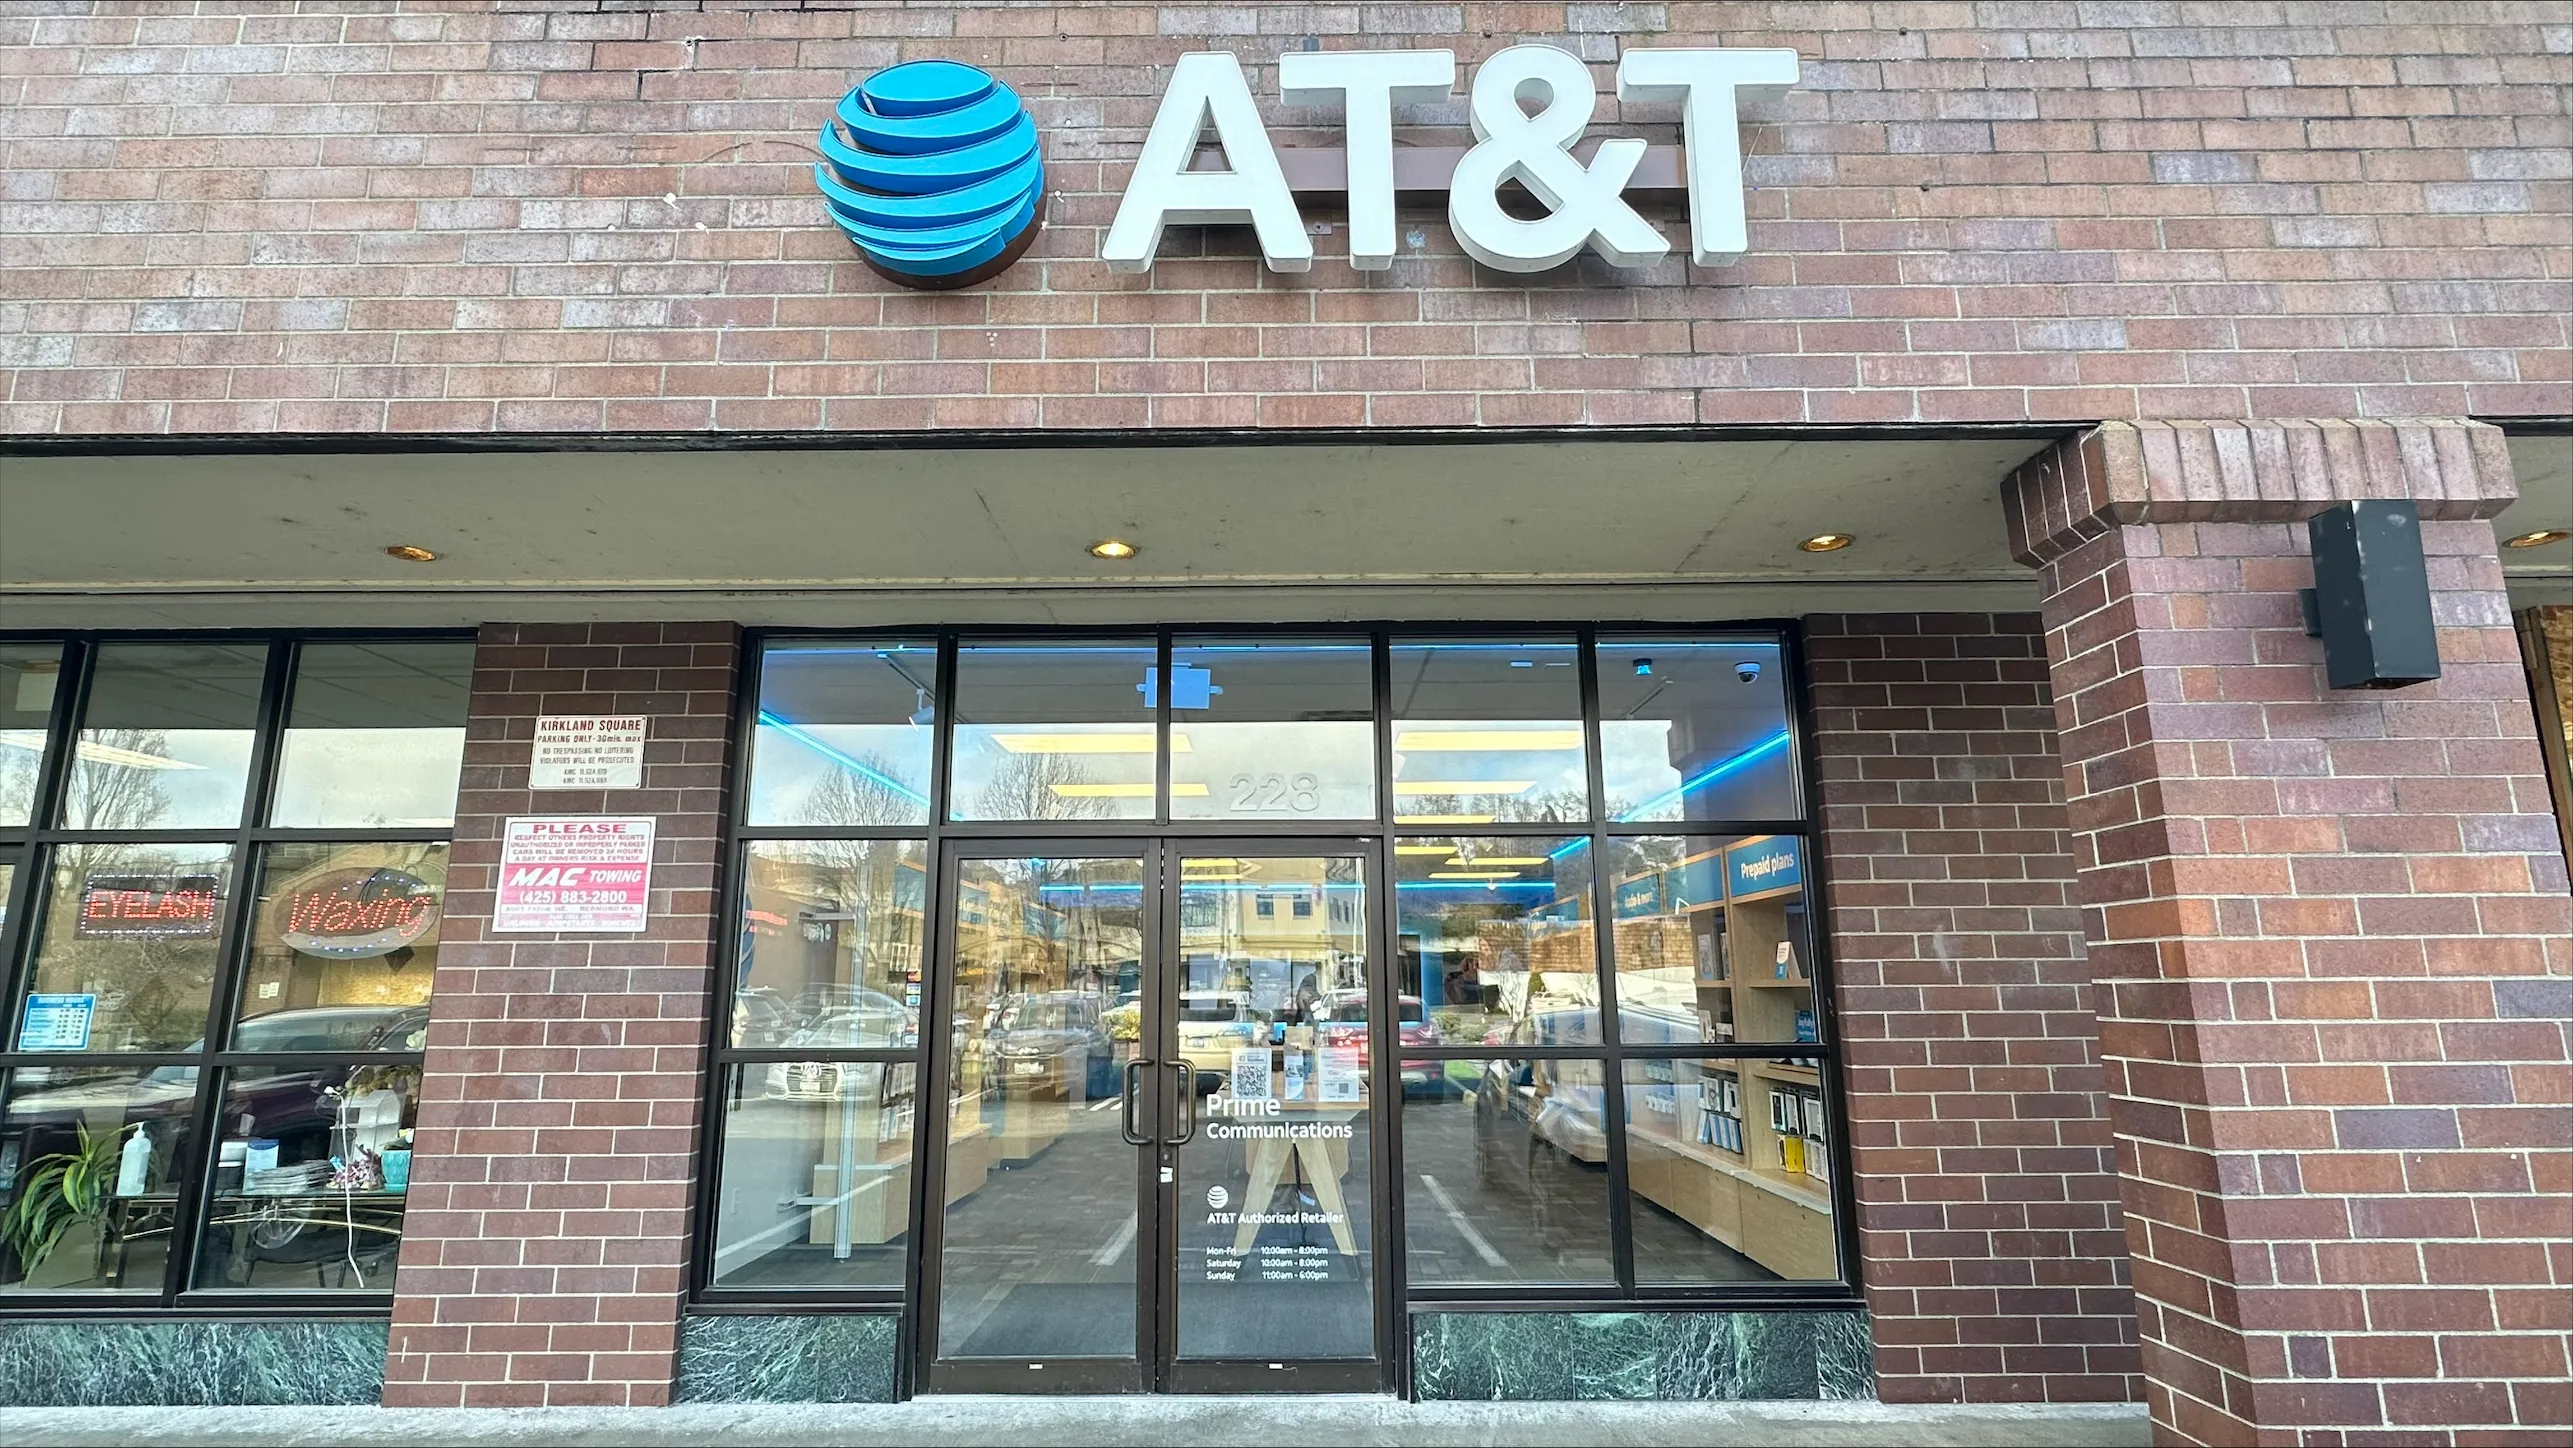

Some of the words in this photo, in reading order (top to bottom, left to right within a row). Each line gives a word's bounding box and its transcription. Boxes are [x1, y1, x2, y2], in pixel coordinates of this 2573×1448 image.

[1101, 43, 1800, 273] AT&T
[541, 720, 594, 731] KIRKLAND
[599, 720, 641, 732] SQUARE
[538, 735, 570, 743] PARKING
[1230, 772, 1320, 812] 228
[533, 824, 627, 834] PLEASE
[1740, 854, 1770, 880] Prepaid
[1770, 852, 1795, 877] plans
[508, 867, 587, 887] MAC
[588, 870, 643, 883] TOWING
[88, 890, 212, 919] EYELASH
[519, 890, 556, 904] (425)
[560, 890, 627, 904] 883-2800
[288, 888, 432, 938] Waxing
[1206, 1094, 1281, 1117] Prime
[1206, 1121, 1353, 1139] Communications
[1207, 1213, 1237, 1224] AT&T
[1238, 1212, 1299, 1224] Authorized
[1301, 1212, 1345, 1224] Retailer
[1207, 1247, 1237, 1255] Mon-Fri
[1260, 1247, 1293, 1255] 10:00am
[1206, 1259, 1241, 1268] Saturday
[1260, 1259, 1293, 1267] 10:00am
[1206, 1271, 1236, 1281] Sunday
[1262, 1271, 1293, 1279] 11:00am
[1299, 1271, 1329, 1281] 6:00pm
